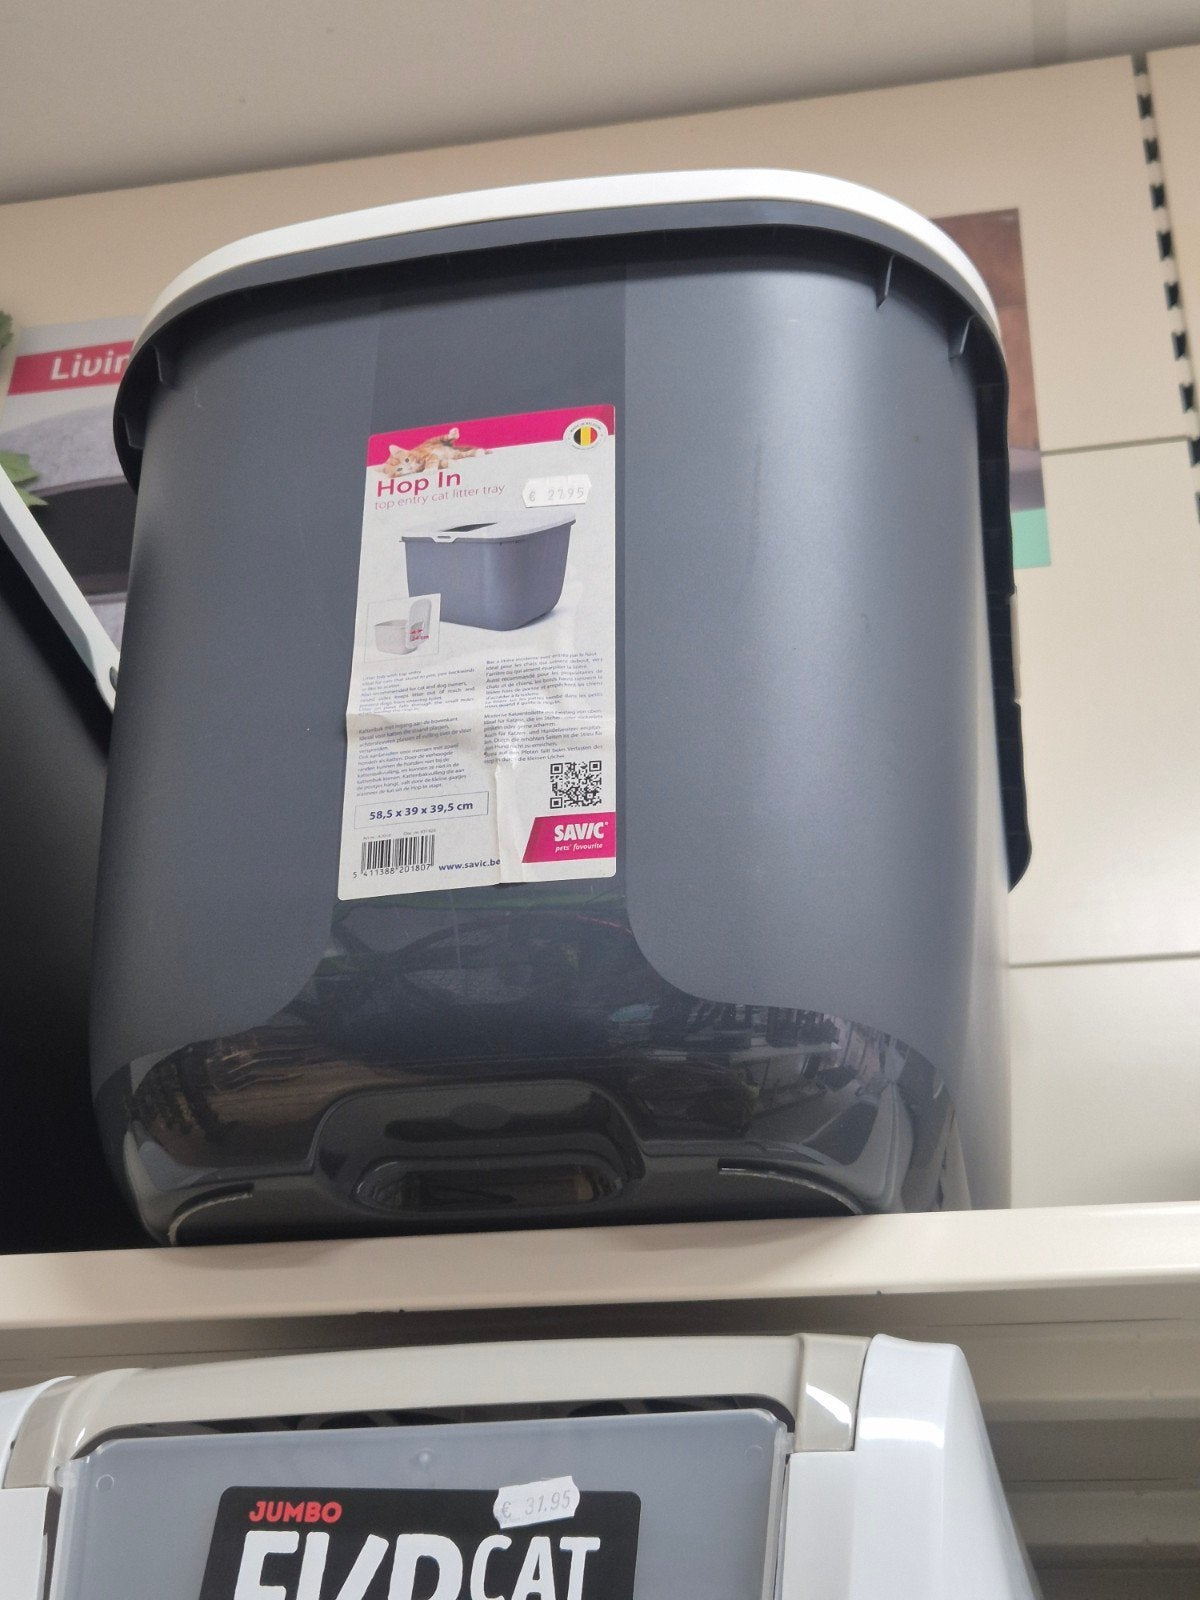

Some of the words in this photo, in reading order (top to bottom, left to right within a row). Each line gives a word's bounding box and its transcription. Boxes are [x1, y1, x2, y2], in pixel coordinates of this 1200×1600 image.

[377, 478, 429, 497] Hop
[438, 472, 461, 488] In
[375, 500, 395, 510] top
[398, 495, 428, 506] entry
[431, 492, 449, 501] cat
[453, 488, 479, 498] litter
[483, 485, 506, 496] tray
[369, 809, 393, 820] 58,5
[405, 806, 418, 816] 39
[430, 803, 454, 813] 39,5
[457, 802, 473, 810] cm
[554, 822, 605, 842] SAVIC
[573, 842, 603, 852] favourite
[399, 864, 432, 874] 201807
[439, 858, 501, 871] www.savic.be
[249, 1501, 343, 1524] JUMBO
[501, 1501, 512, 1519] €
[525, 1490, 571, 1516] 31.95
[470, 1534, 600, 1600] CAT
